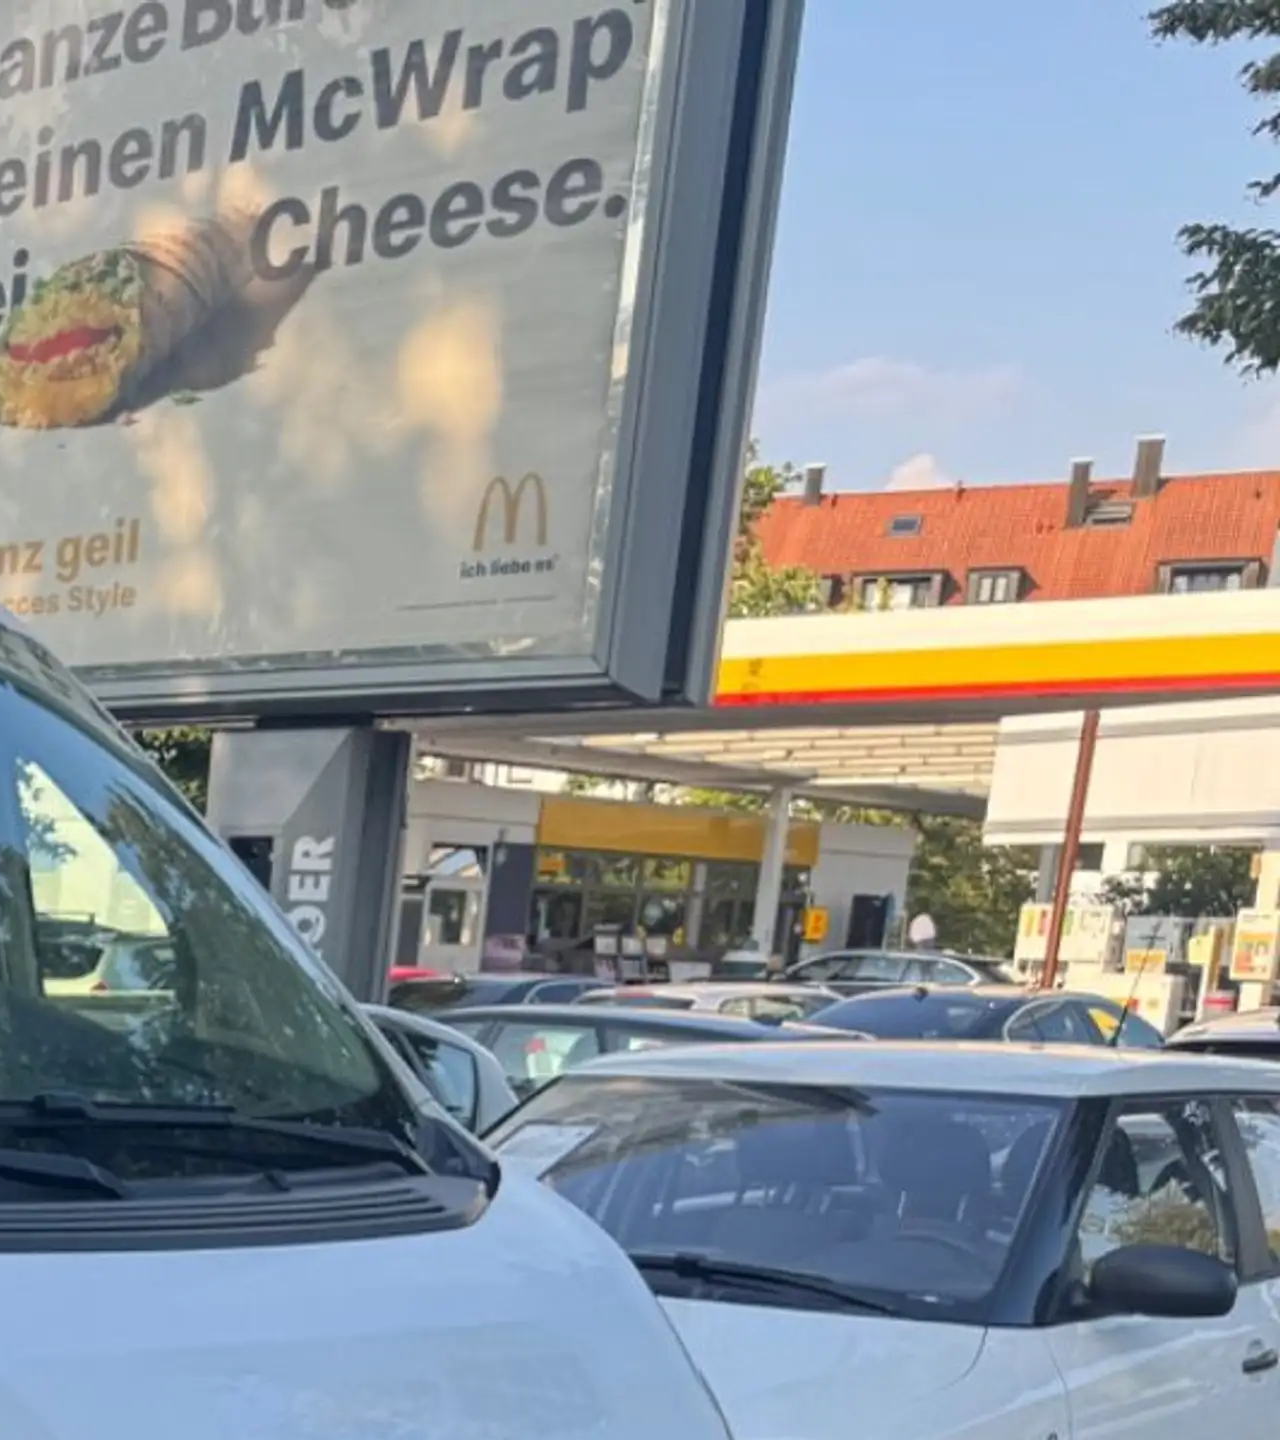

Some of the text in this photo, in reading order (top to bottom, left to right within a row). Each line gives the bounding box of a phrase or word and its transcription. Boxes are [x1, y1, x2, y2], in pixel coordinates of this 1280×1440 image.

[229, 7, 634, 162] McWrap
[250, 157, 630, 281] Cheese.
[55, 517, 140, 582] geil
[460, 560, 487, 578] ich
[67, 581, 137, 619] Style
